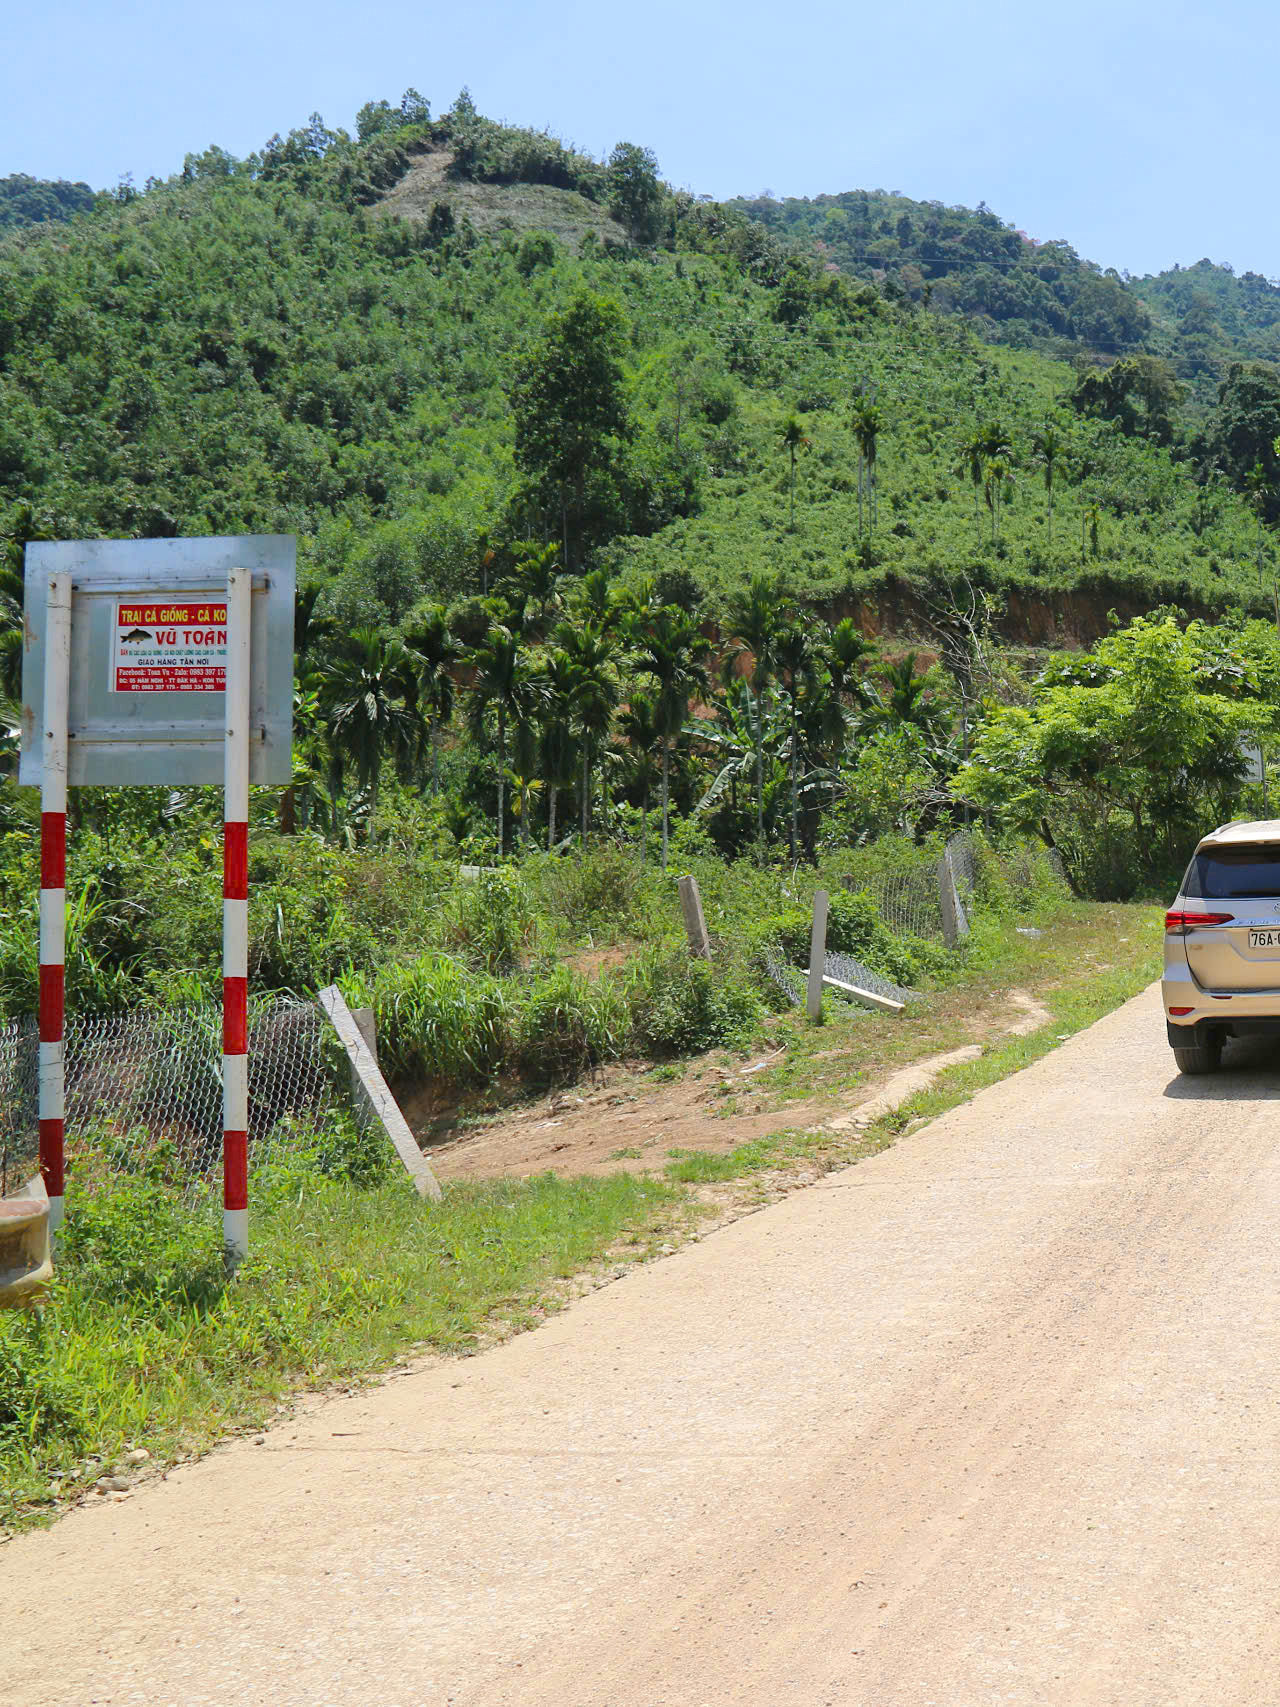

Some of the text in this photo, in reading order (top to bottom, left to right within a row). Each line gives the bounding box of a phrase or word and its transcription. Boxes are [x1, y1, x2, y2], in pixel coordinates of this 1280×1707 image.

[160, 606, 188, 622] GIỐNG
[155, 627, 227, 646] VŨ TOÀN
[137, 658, 155, 666] GIAO
